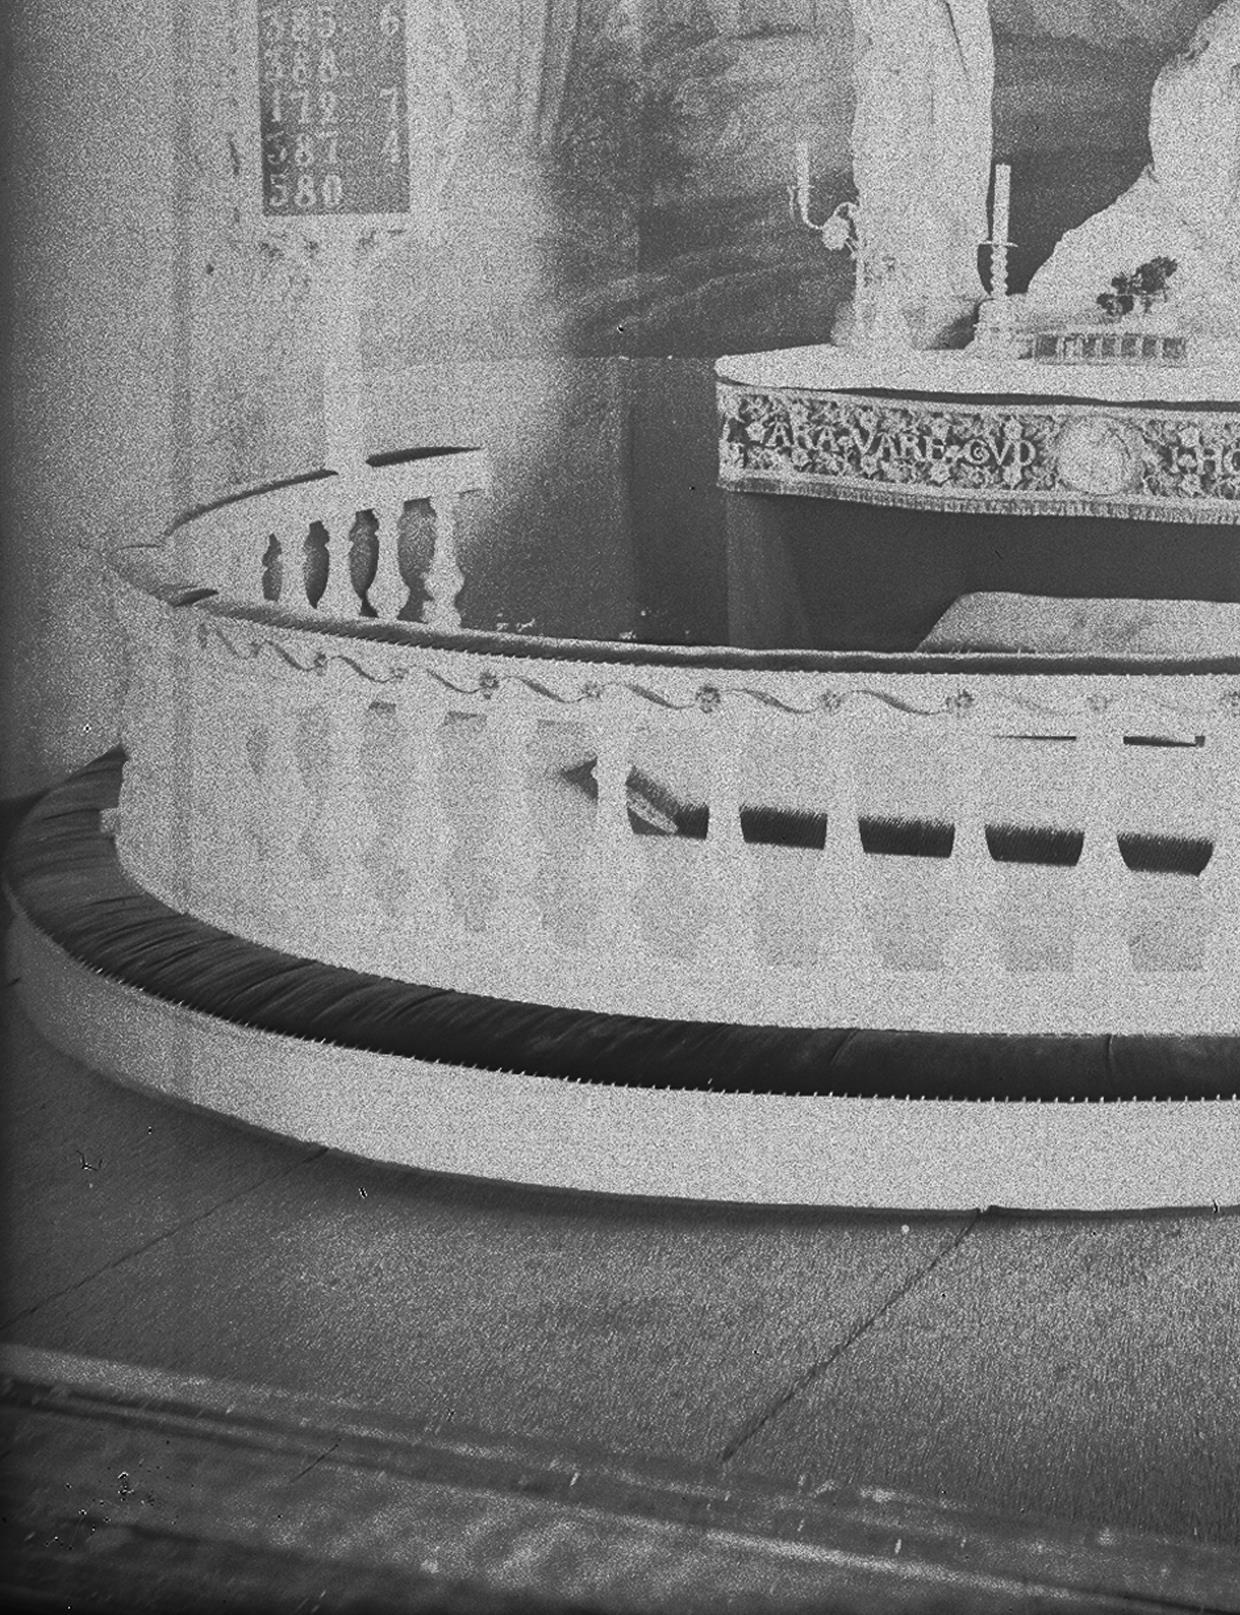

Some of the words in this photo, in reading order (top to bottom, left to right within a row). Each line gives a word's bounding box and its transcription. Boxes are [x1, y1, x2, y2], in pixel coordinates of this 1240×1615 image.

[379, 1, 399, 37] 6
[270, 173, 343, 208] 580
[849, 426, 947, 462] VARE
